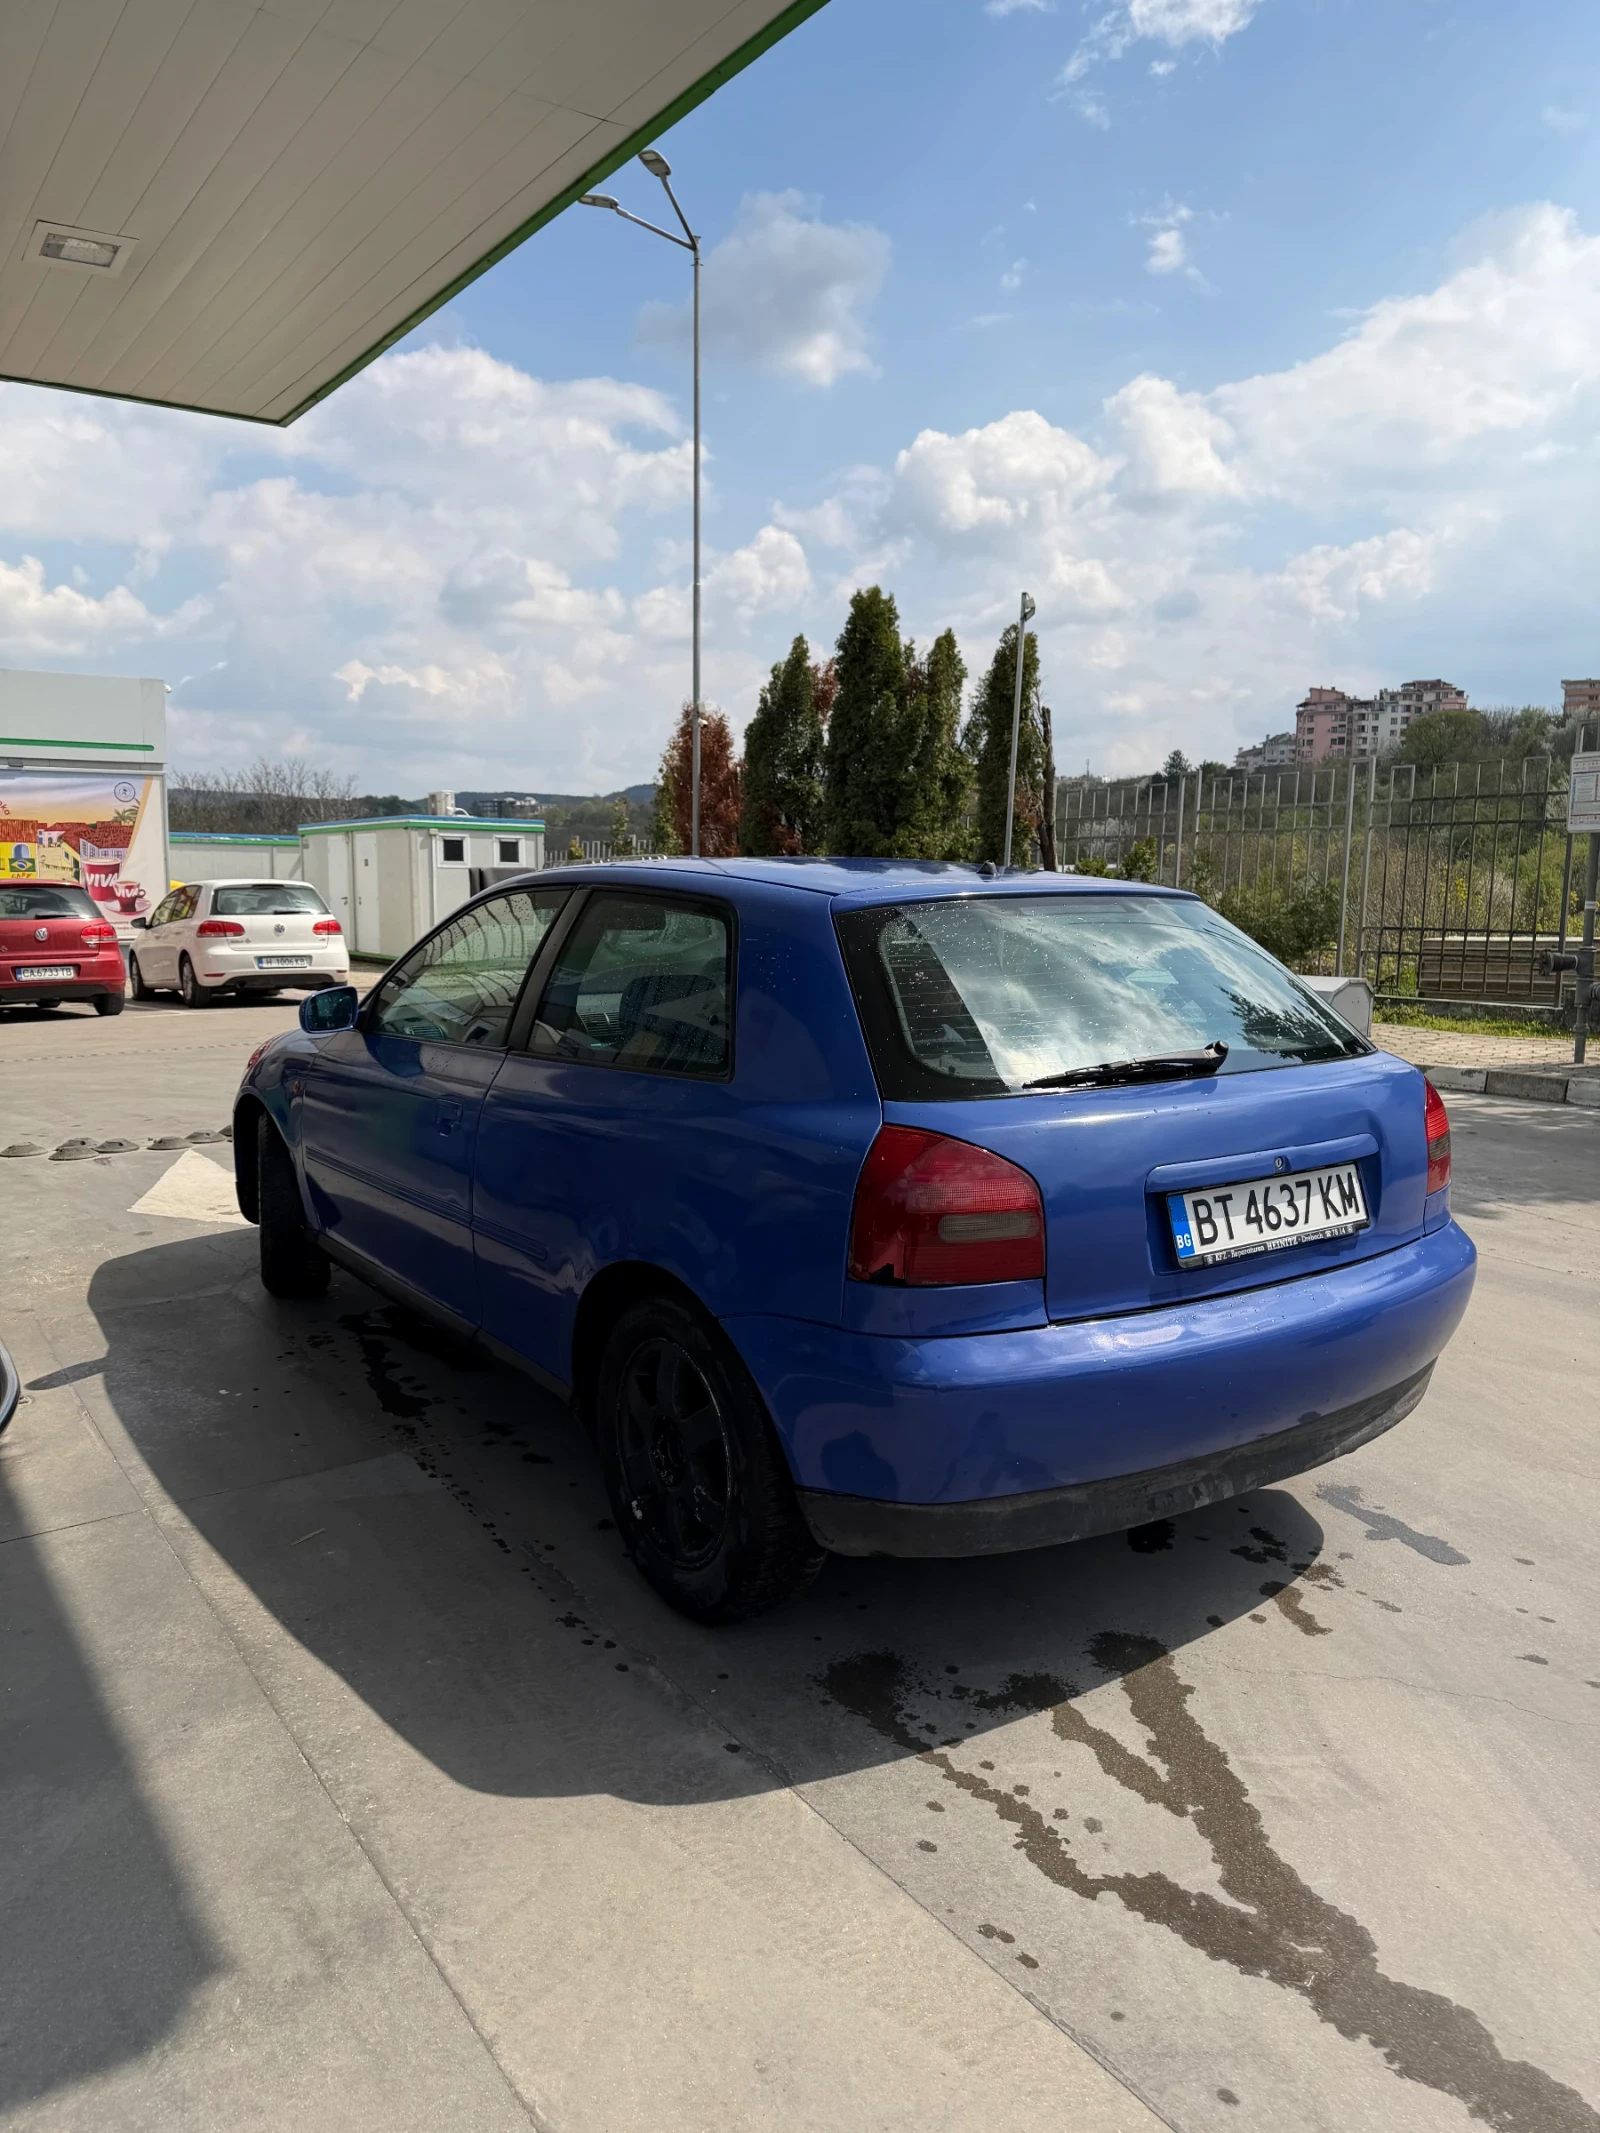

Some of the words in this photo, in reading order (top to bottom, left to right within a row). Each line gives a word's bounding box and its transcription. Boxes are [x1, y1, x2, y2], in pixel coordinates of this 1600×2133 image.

[85, 872, 118, 888] VIVA
[113, 885, 139, 898] VIVA
[22, 968, 36, 978] CA
[60, 967, 73, 977] TB
[1192, 1193, 1235, 1247] BT
[1245, 1179, 1311, 1234] 4637
[1318, 1171, 1360, 1220] KM
[1175, 1233, 1193, 1250] BG
[1266, 1236, 1299, 1251] HEINITZ
